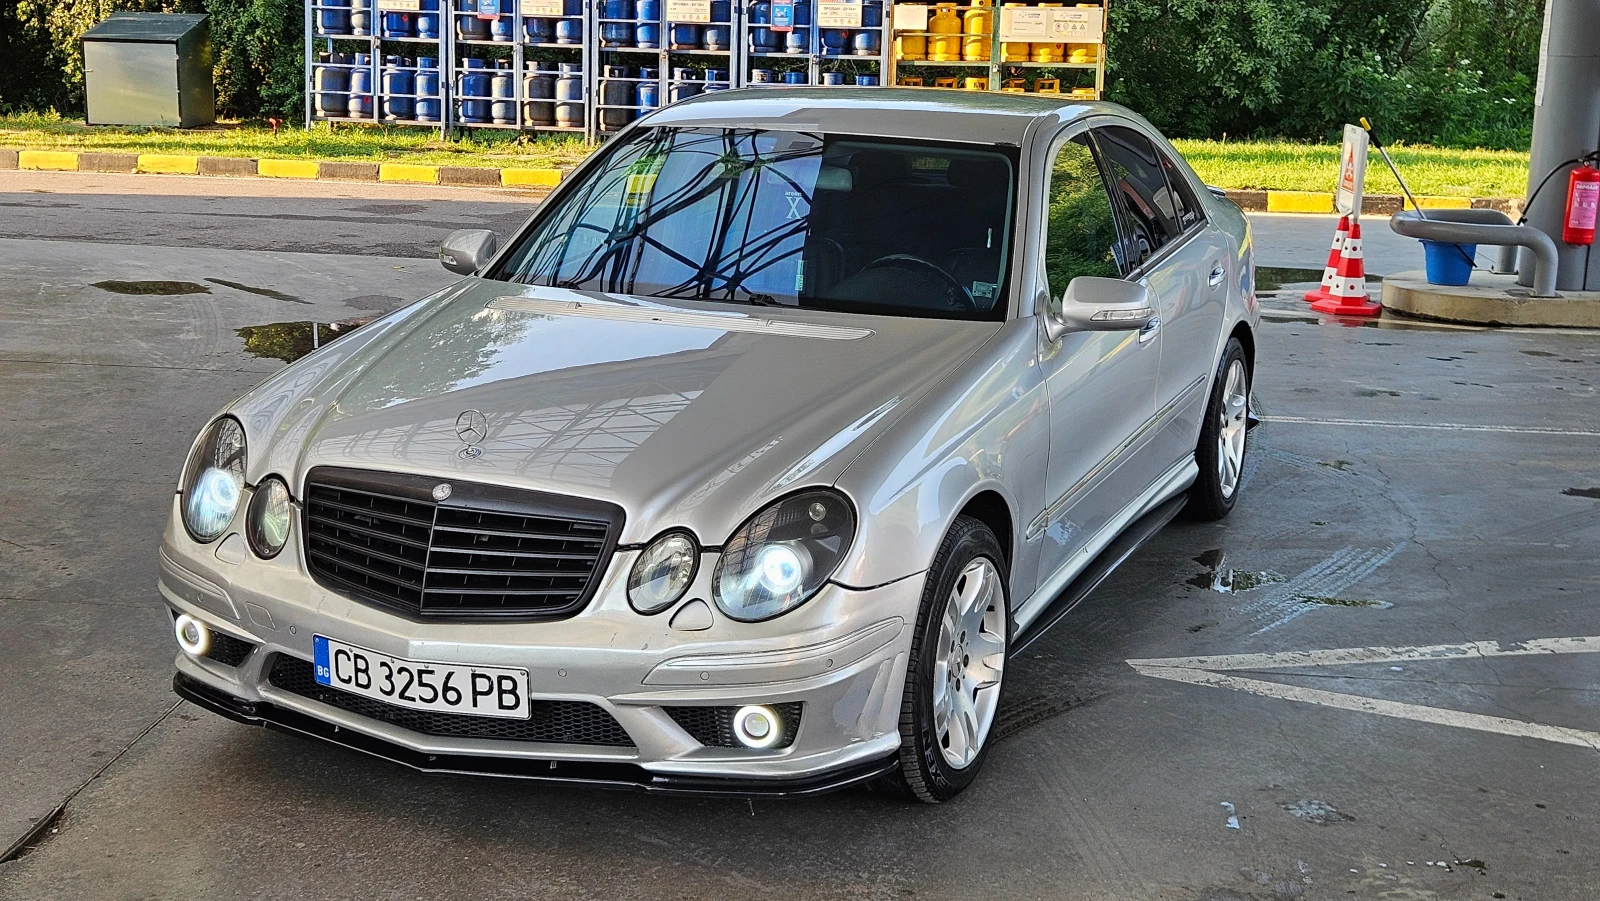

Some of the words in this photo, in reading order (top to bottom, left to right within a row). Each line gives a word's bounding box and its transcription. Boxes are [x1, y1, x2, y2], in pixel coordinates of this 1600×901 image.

[785, 197, 802, 219] X
[317, 665, 330, 678] BG
[334, 649, 372, 690] CB
[379, 662, 463, 706] 3256
[470, 672, 521, 710] PB
